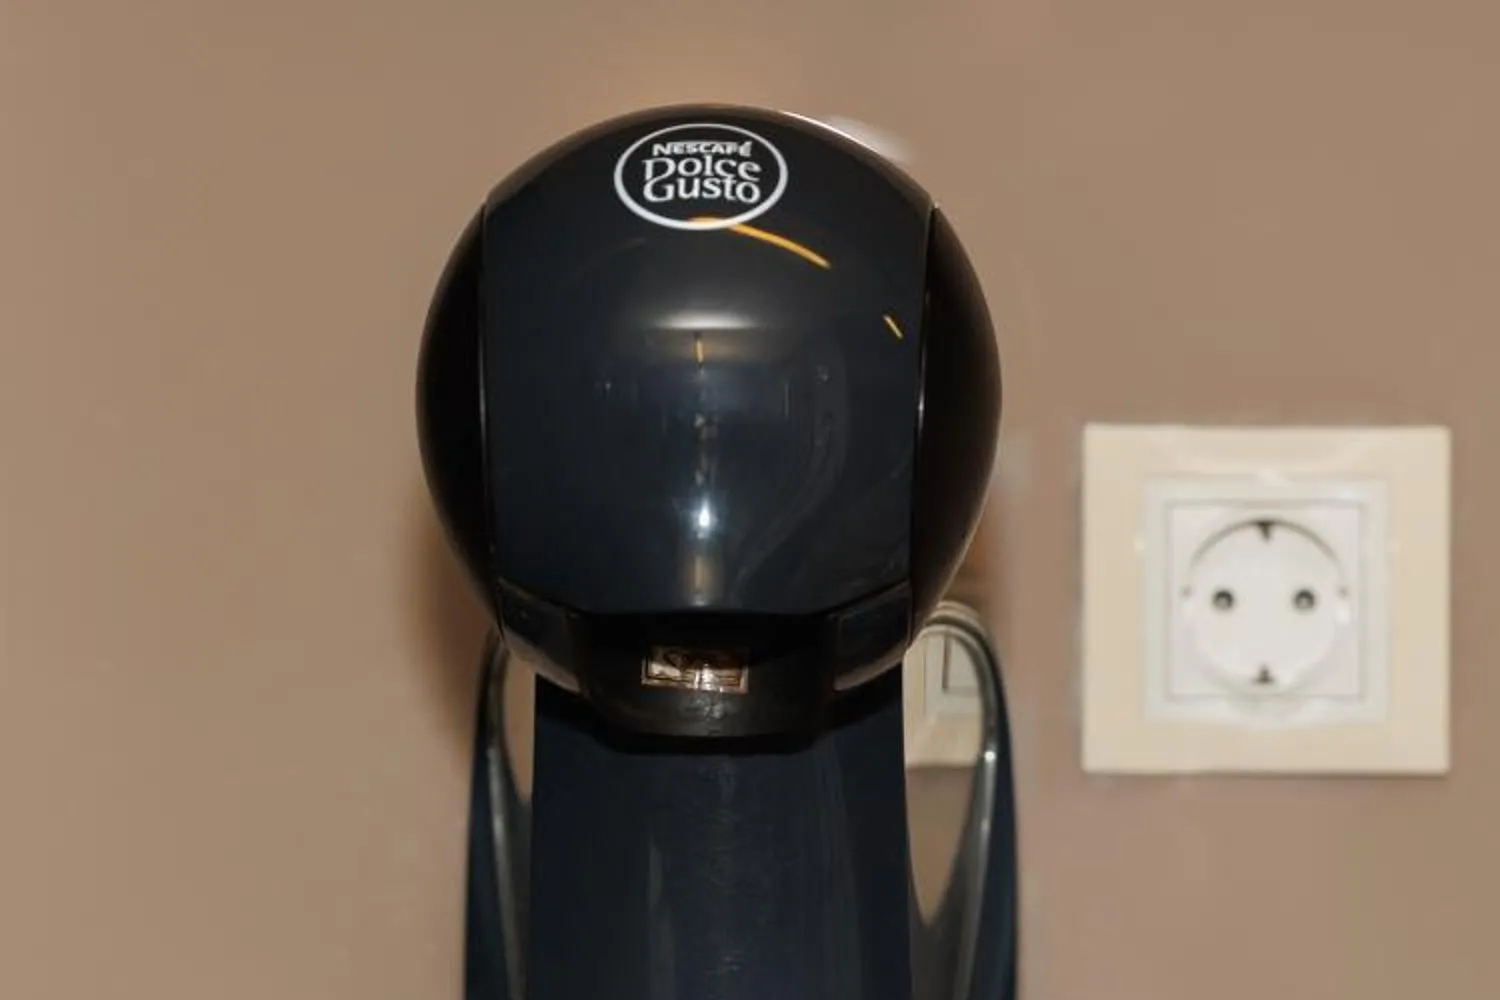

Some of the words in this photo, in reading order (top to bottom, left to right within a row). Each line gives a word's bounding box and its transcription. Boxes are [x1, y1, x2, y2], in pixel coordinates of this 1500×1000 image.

[652, 141, 753, 157] NESCAFÉ
[643, 155, 762, 183] Dolce
[643, 176, 762, 204] Gusto
